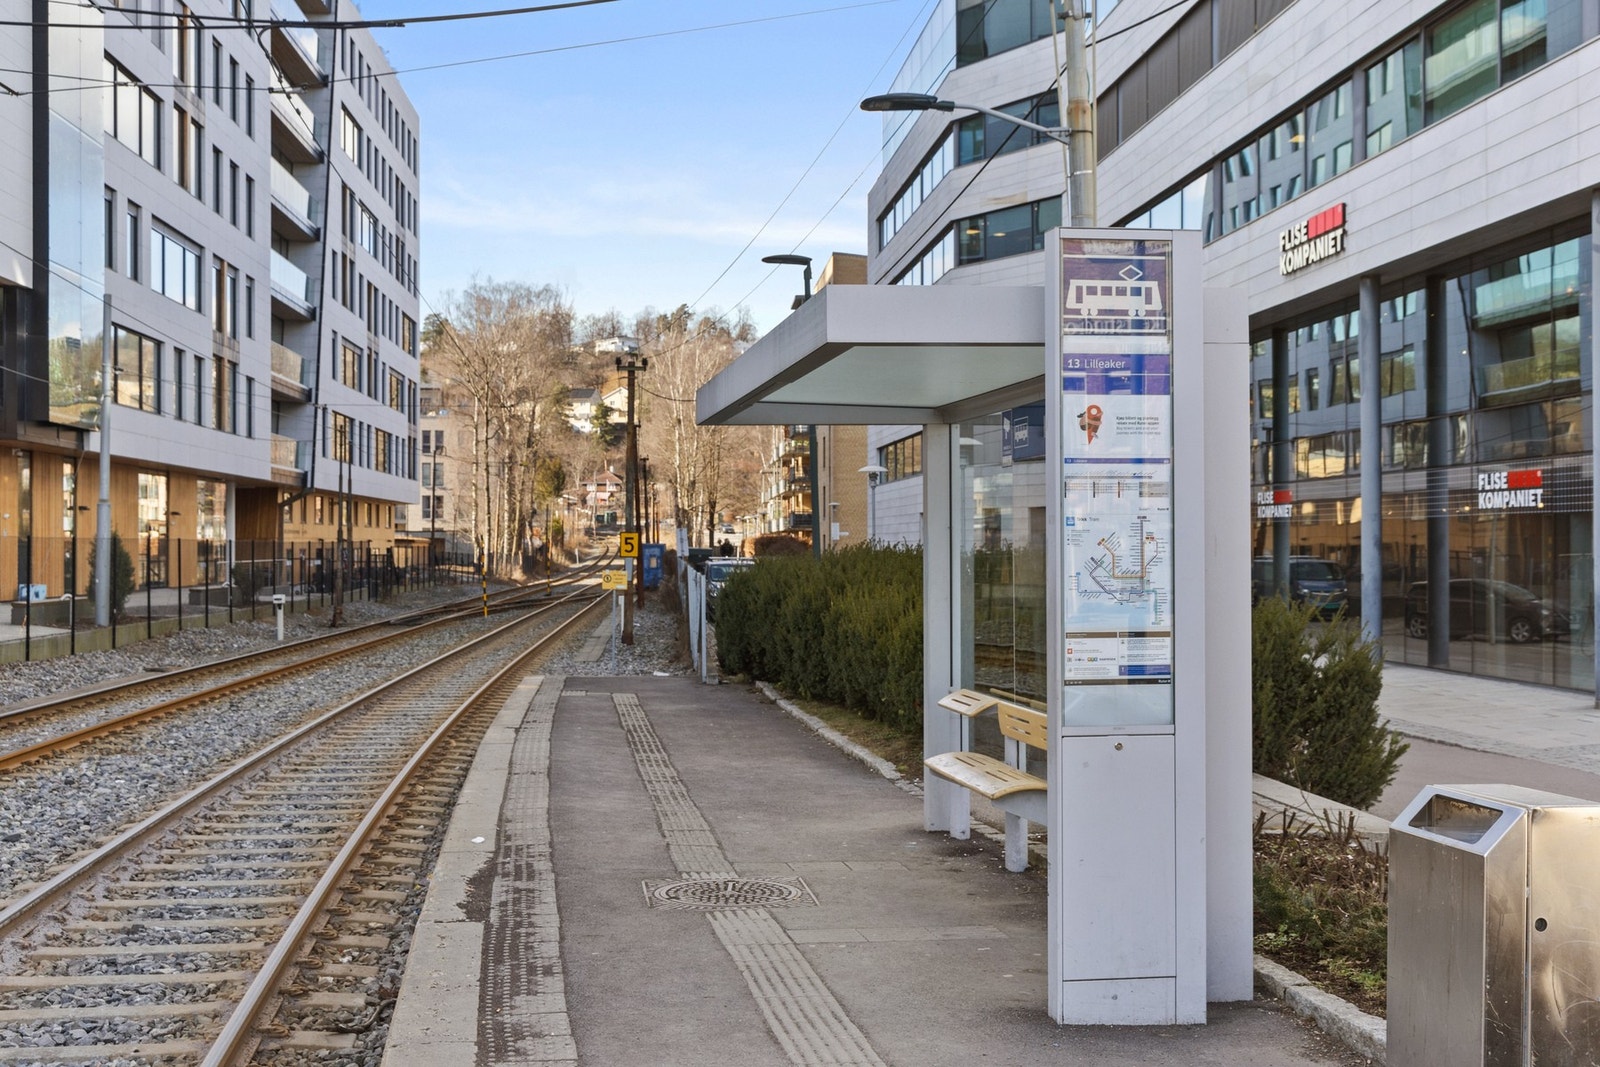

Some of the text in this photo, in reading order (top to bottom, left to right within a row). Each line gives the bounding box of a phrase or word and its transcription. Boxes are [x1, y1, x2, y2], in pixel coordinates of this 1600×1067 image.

[1280, 220, 1308, 252] FLISE
[1280, 228, 1343, 275] KOMPANIET
[1067, 358, 1126, 369] 13 Lilleaker
[1479, 471, 1508, 490] FLISE
[1257, 491, 1274, 505] FLISE
[1479, 488, 1543, 509] KOMPANIET
[1257, 504, 1292, 518] KOMPANIET
[624, 537, 634, 553] 5
